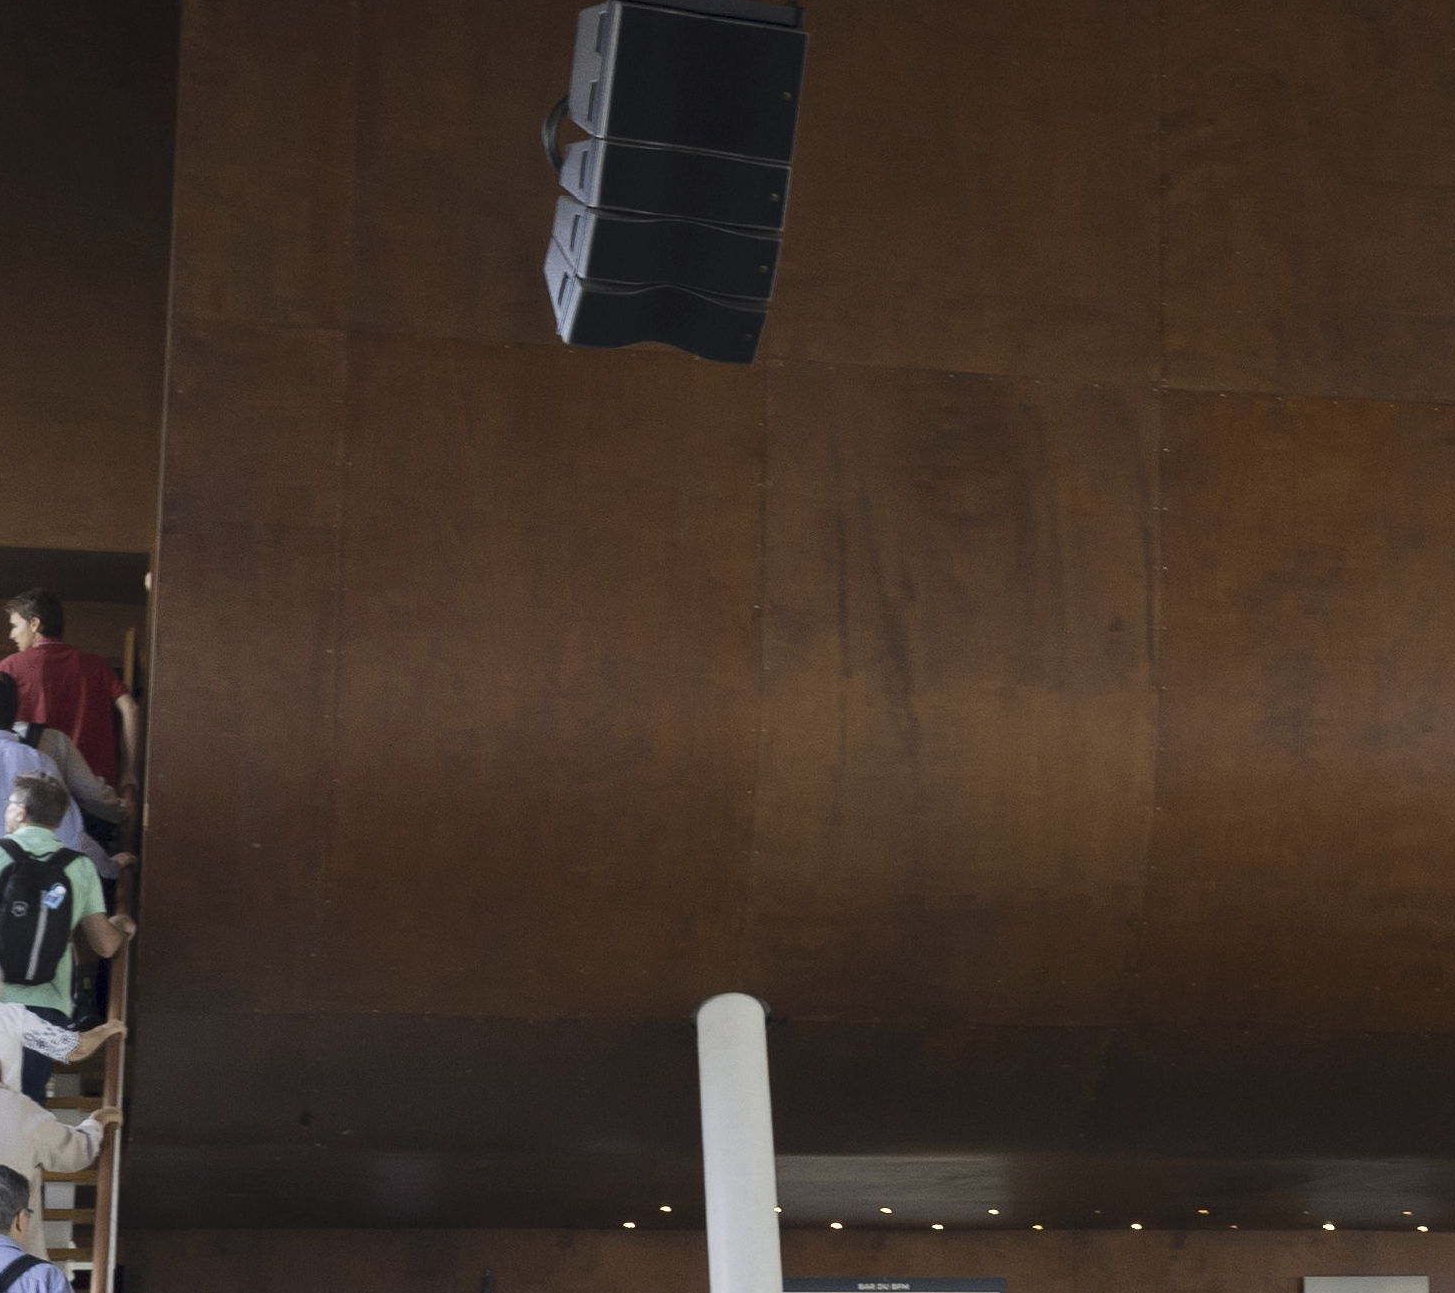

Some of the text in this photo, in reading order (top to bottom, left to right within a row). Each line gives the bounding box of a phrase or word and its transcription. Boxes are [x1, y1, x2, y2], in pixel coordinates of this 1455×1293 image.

[857, 1283, 910, 1291] BAR DU BFM
